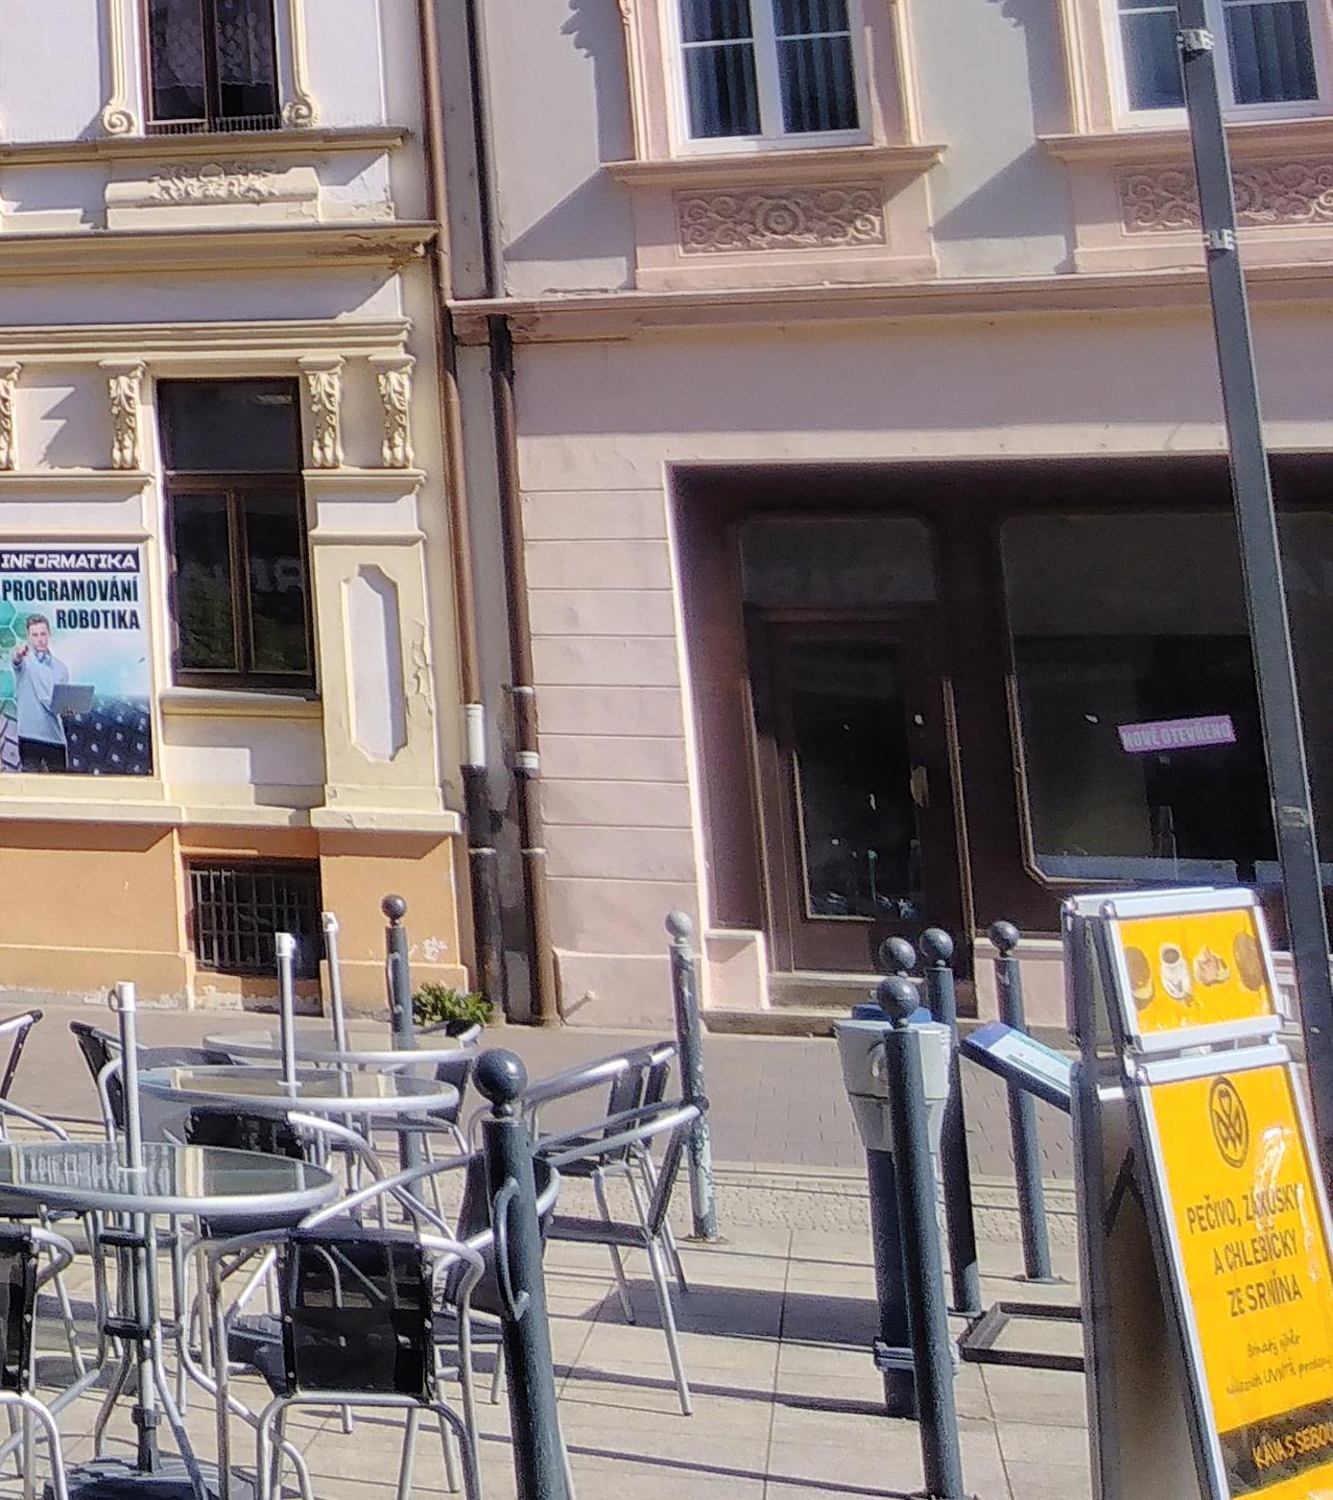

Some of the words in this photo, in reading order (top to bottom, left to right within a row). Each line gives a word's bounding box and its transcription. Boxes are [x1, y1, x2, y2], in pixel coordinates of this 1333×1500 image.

[1, 552, 137, 570] INFORMATIKA
[1, 575, 139, 602] PROGRAMOVÁNÍ
[56, 608, 141, 630] ROBOTIKA
[1186, 1194, 1242, 1235] PEČIVO,
[1213, 1247, 1225, 1275] A
[1224, 1224, 1298, 1272] CHLEBÍČKY
[1226, 1287, 1247, 1317] ZE
